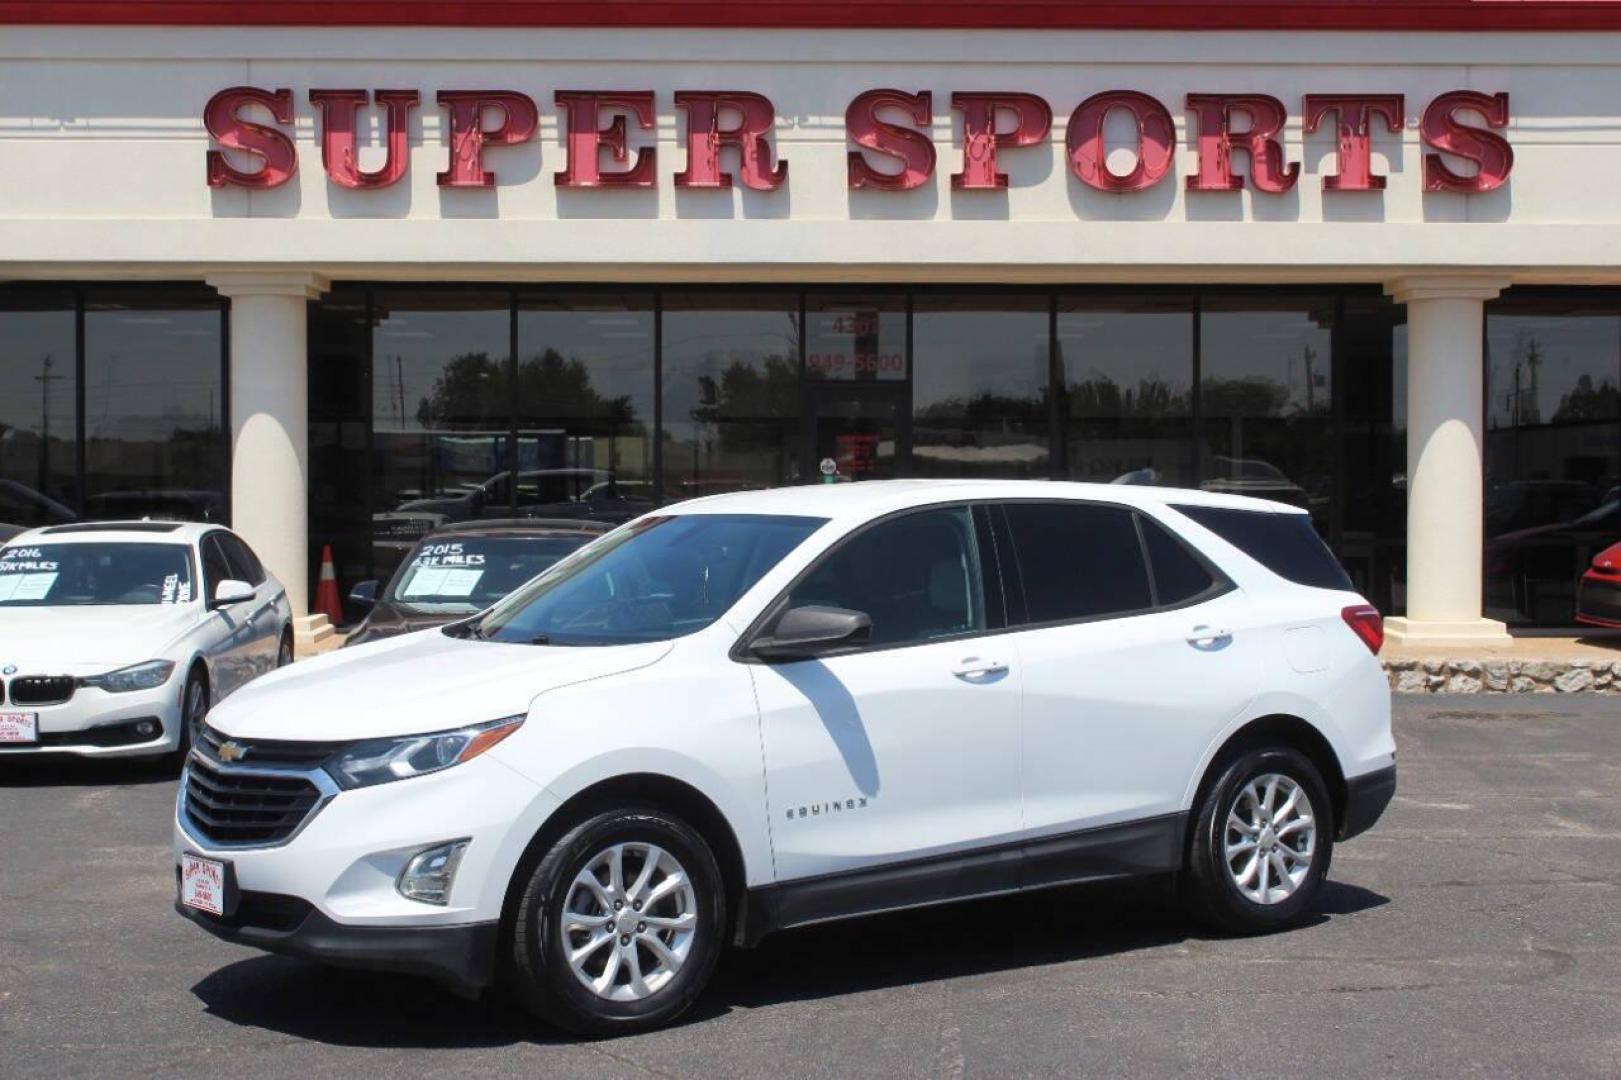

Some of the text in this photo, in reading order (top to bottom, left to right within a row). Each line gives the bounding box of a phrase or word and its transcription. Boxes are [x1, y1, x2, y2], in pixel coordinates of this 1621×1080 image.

[203, 86, 1514, 194] SUPER SPORTS
[2, 548, 42, 560] 2016
[420, 543, 464, 556] 2015
[442, 554, 486, 566] MILES
[786, 798, 867, 820] EQUINOX
